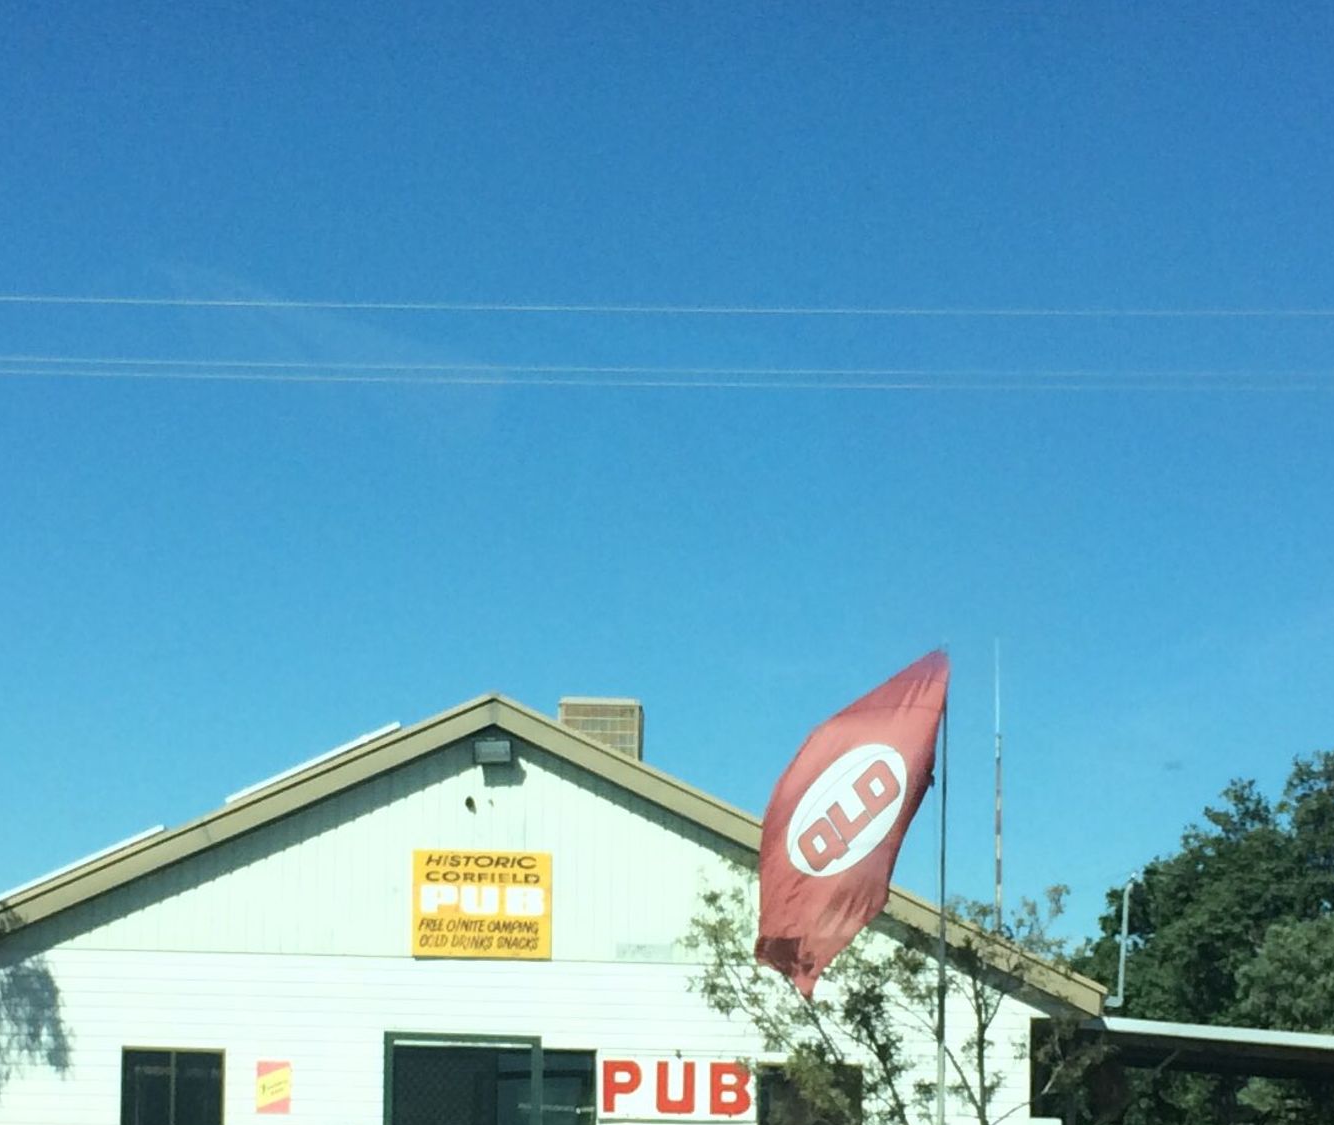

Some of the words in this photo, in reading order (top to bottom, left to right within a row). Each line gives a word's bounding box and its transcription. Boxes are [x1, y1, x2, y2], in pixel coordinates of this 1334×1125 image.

[797, 759, 901, 873] QLD
[425, 853, 538, 870] HISTORIC
[425, 870, 540, 884] CORFIELD
[419, 884, 545, 917] PUB
[418, 917, 445, 932] FREE
[487, 920, 540, 935] CAMPING
[450, 934, 494, 951] DRINKS
[496, 936, 540, 951] SNACKS
[602, 1060, 752, 1116] PUB
